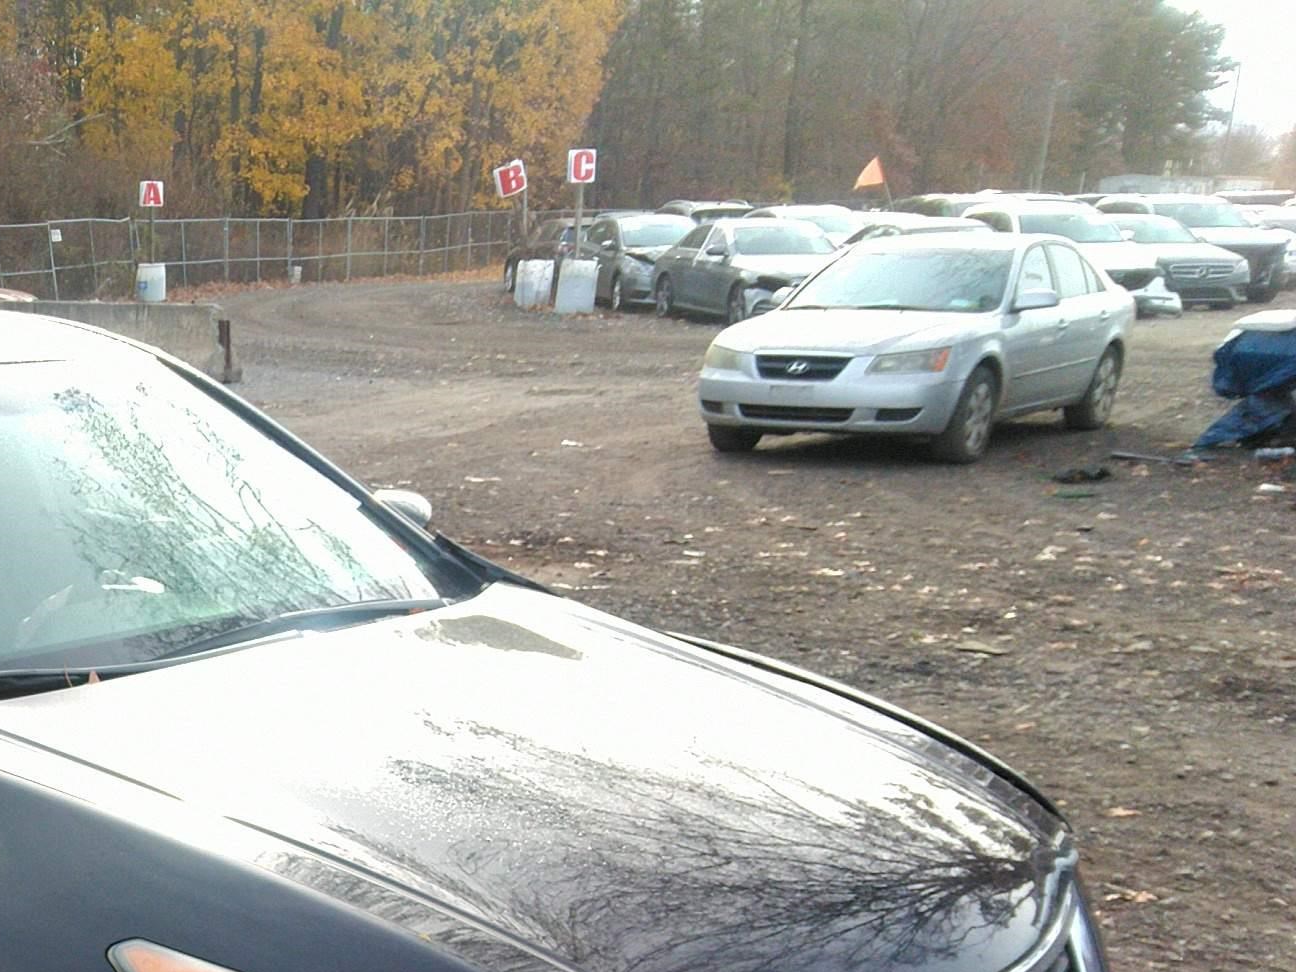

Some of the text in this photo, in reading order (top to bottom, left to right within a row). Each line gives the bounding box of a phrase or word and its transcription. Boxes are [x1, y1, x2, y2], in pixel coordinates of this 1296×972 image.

[498, 165, 525, 195] B
[573, 150, 594, 181] C
[143, 182, 161, 205] A
